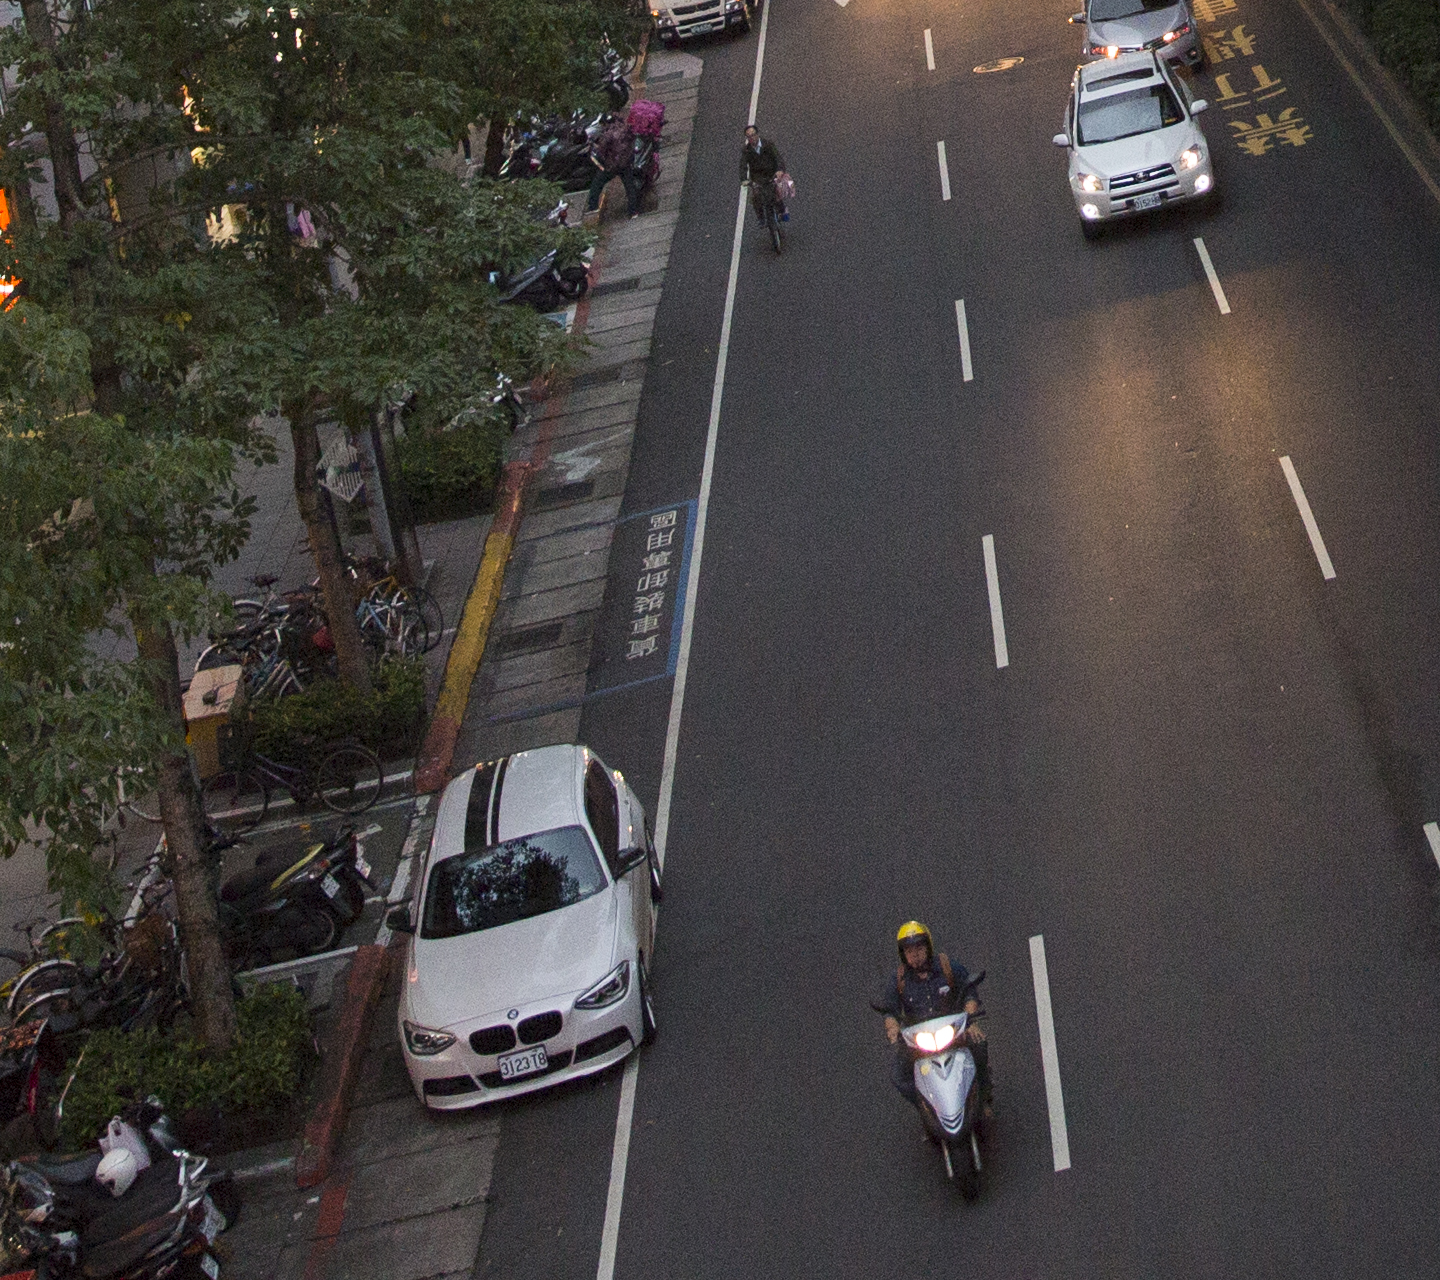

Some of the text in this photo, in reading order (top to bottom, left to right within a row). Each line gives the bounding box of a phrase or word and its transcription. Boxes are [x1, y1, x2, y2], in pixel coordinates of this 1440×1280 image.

[626, 509, 678, 661] 貨車裝卸專用區
